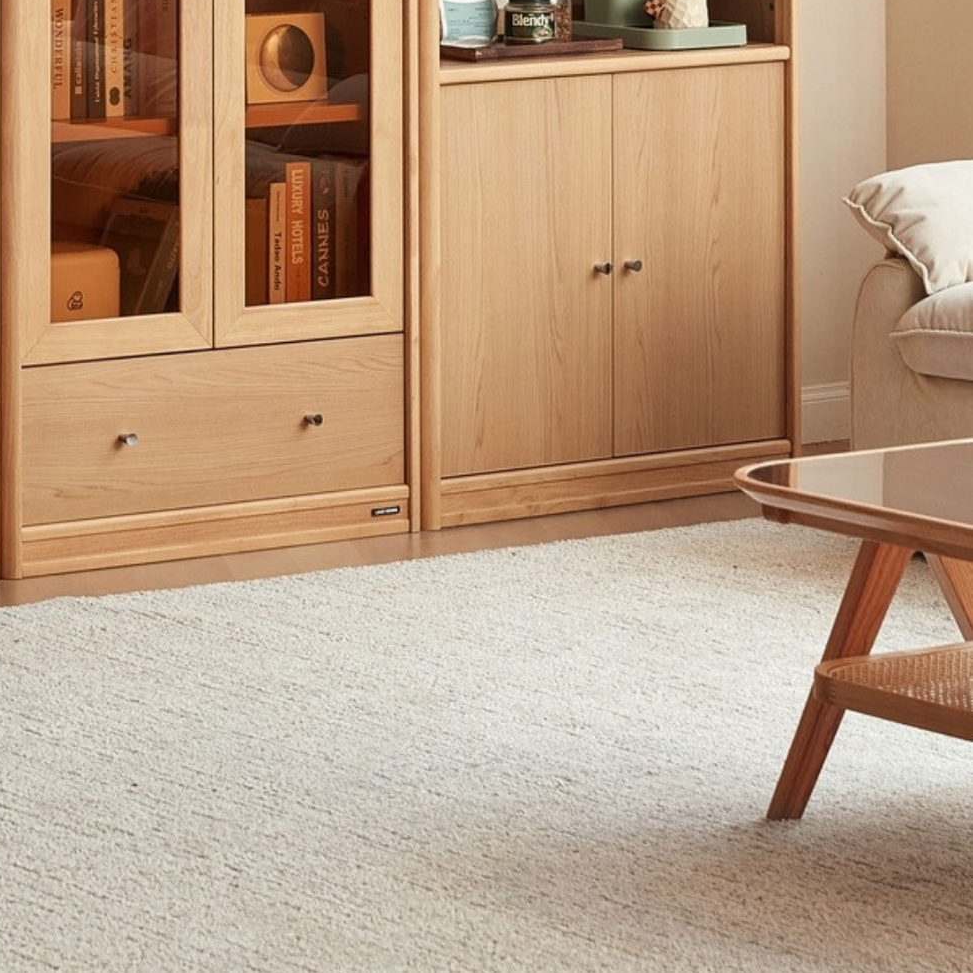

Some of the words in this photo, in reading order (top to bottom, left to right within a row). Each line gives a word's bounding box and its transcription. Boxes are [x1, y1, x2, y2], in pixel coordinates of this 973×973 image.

[512, 13, 549, 28] Blendy
[54, 7, 64, 90] WONDERFUL
[291, 169, 304, 215] LUXURY
[291, 220, 304, 265] HOTELS
[317, 209, 330, 286] CANNES
[274, 264, 282, 291] Ando
